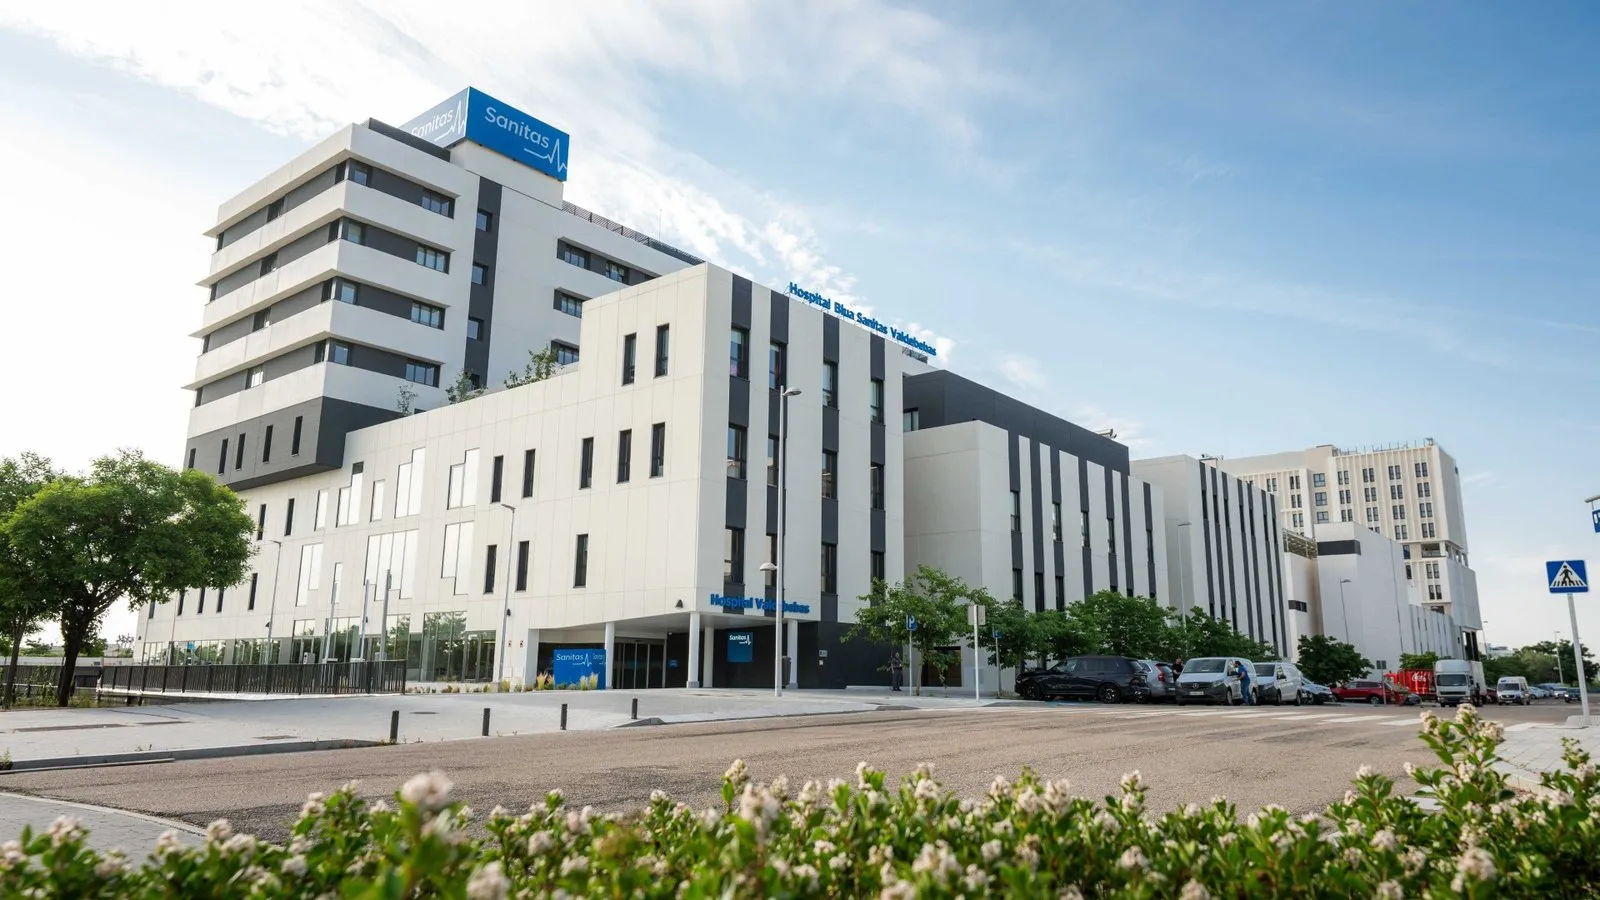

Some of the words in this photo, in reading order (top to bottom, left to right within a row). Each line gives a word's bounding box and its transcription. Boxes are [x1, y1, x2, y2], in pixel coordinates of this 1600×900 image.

[485, 106, 550, 148] Sanitas
[789, 282, 831, 310] Hospital
[834, 302, 855, 321] Blua
[856, 312, 888, 334] Sanitas
[890, 327, 937, 356] Valdebebas
[710, 593, 753, 608] Hospital
[755, 597, 809, 613] Valbebas
[556, 653, 584, 661] Sanitas
